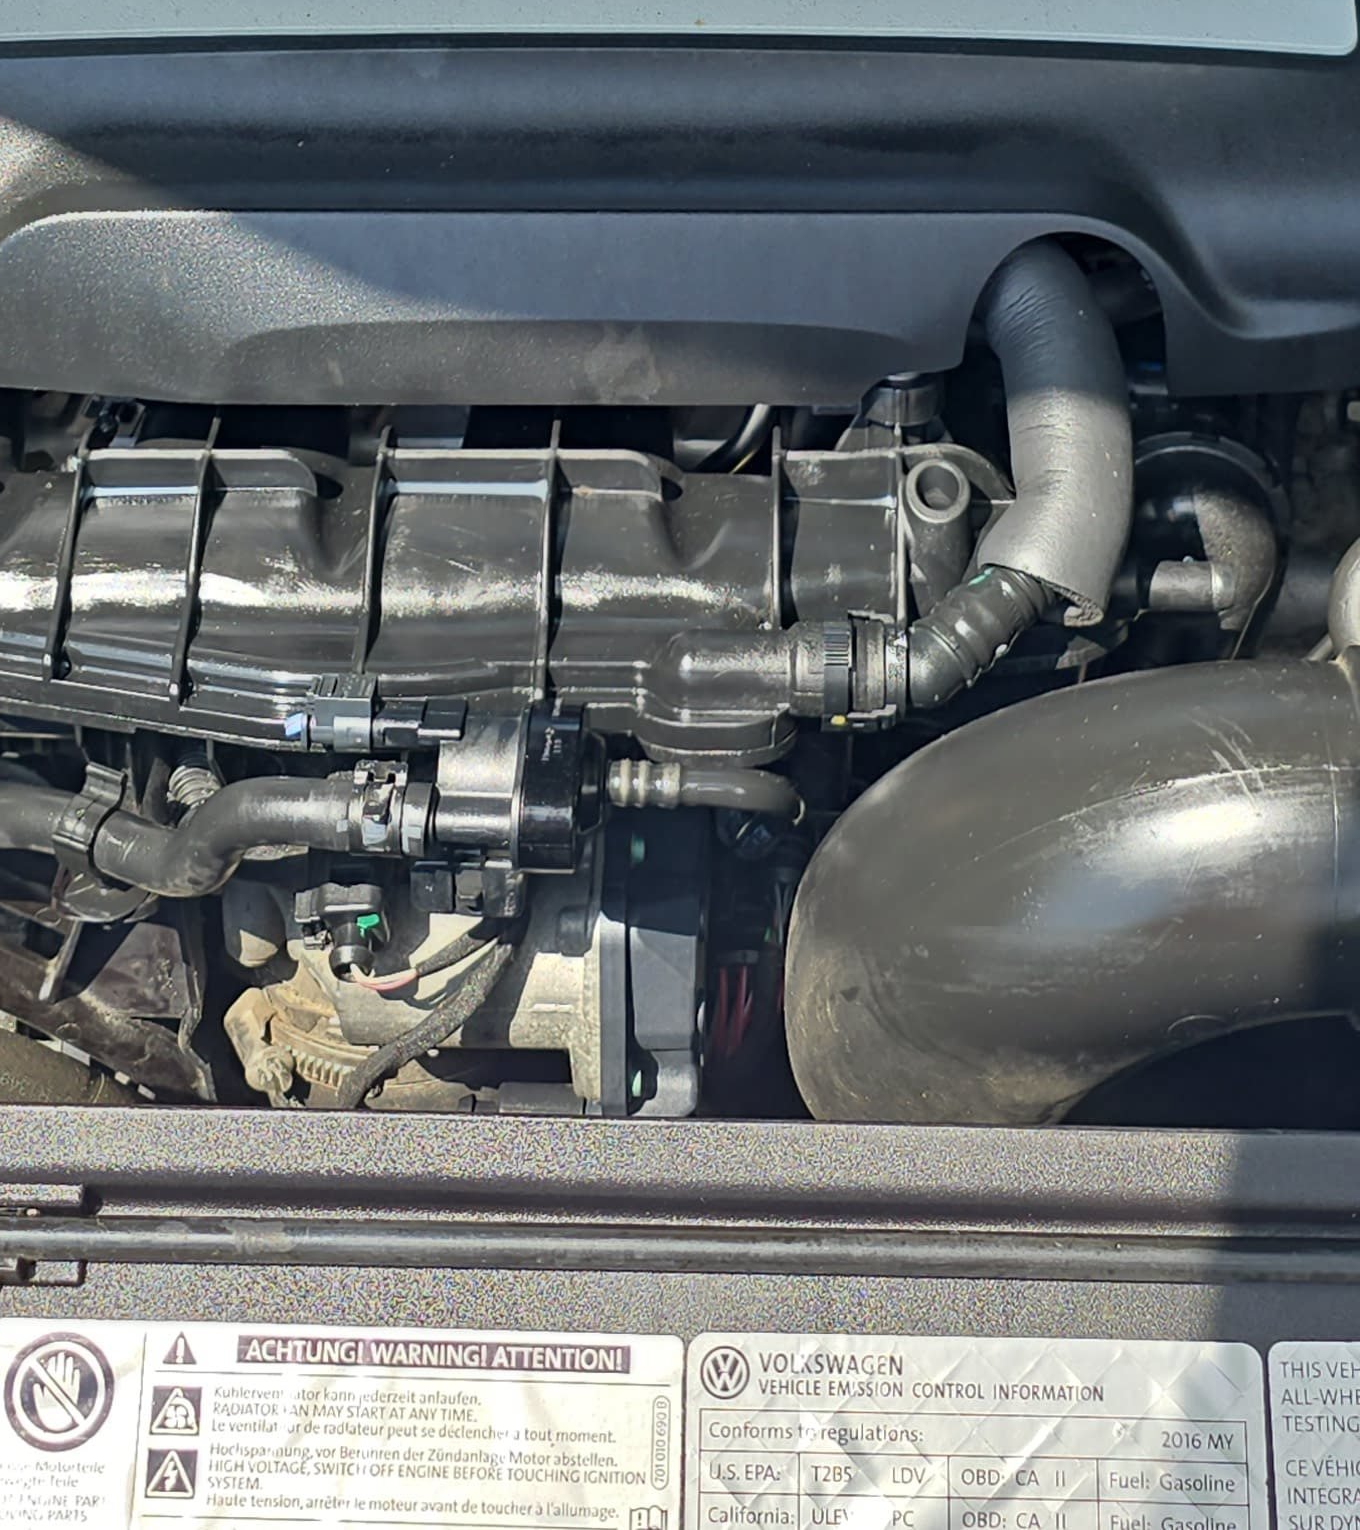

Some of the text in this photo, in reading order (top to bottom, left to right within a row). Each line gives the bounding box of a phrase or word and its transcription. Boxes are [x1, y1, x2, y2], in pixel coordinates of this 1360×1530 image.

[245, 1338, 623, 1371] ACHTUNG! WARNING! ATTENTION!
[758, 1352, 904, 1376] VOLKSWAGEN
[1280, 1361, 1319, 1379] THIS
[323, 1388, 355, 1402] kann
[358, 1388, 416, 1406] jederzeit
[419, 1392, 482, 1406] anlaufen.
[758, 1379, 1104, 1401] VEHICLE EMISSION CONTROL INFORMATION
[213, 1402, 279, 1417] RADIATOR
[313, 1404, 343, 1417] MAY
[347, 1406, 388, 1419] START
[389, 1407, 406, 1419] AT
[409, 1406, 437, 1421] ANY
[441, 1408, 478, 1422] TIME.
[211, 1420, 228, 1433] Le
[303, 1421, 321, 1434] de
[323, 1421, 385, 1437] radiateur
[387, 1424, 420, 1439] peut
[421, 1427, 436, 1438] se
[524, 1428, 552, 1443] tout
[556, 1430, 617, 1444] moment.
[656, 1412, 668, 1437] 690
[1281, 1415, 1360, 1433] TESTING
[709, 1421, 1234, 1450] Conforms to regulations: 2016 MY
[315, 1447, 337, 1458] vor
[403, 1448, 424, 1463] der
[509, 1451, 552, 1466] Motor
[554, 1452, 618, 1468] abstellen.
[655, 1439, 666, 1462] 010
[208, 1459, 646, 1486] HIGH VOLTAGE, SWITCH OFF ENGINE BEFORE TOUCHING IGNITION
[655, 1464, 666, 1483] 701
[709, 1463, 740, 1481] U.S.
[745, 1464, 781, 1481] EPA:
[811, 1465, 853, 1483] T2B5
[892, 1467, 927, 1485] LDV
[961, 1469, 1005, 1486] OBD:
[1015, 1469, 1040, 1487] CA
[1109, 1472, 1150, 1489] Fuel:
[1159, 1473, 1236, 1493] Gasoline
[1286, 1459, 1307, 1477] CE
[207, 1476, 263, 1490] SYSTEM.
[47, 1509, 87, 1522] PARTS
[206, 1493, 619, 1521] Haute tension, arrêter le moteur avant de toucher à l'allumage.
[708, 1506, 795, 1525] California:
[892, 1509, 915, 1528] PC
[962, 1512, 1006, 1528] OBD:
[1016, 1513, 1040, 1530] CA
[1110, 1515, 1151, 1530] Fuel:
[1161, 1516, 1237, 1530] Gasoline
[1290, 1514, 1324, 1530] SUR
